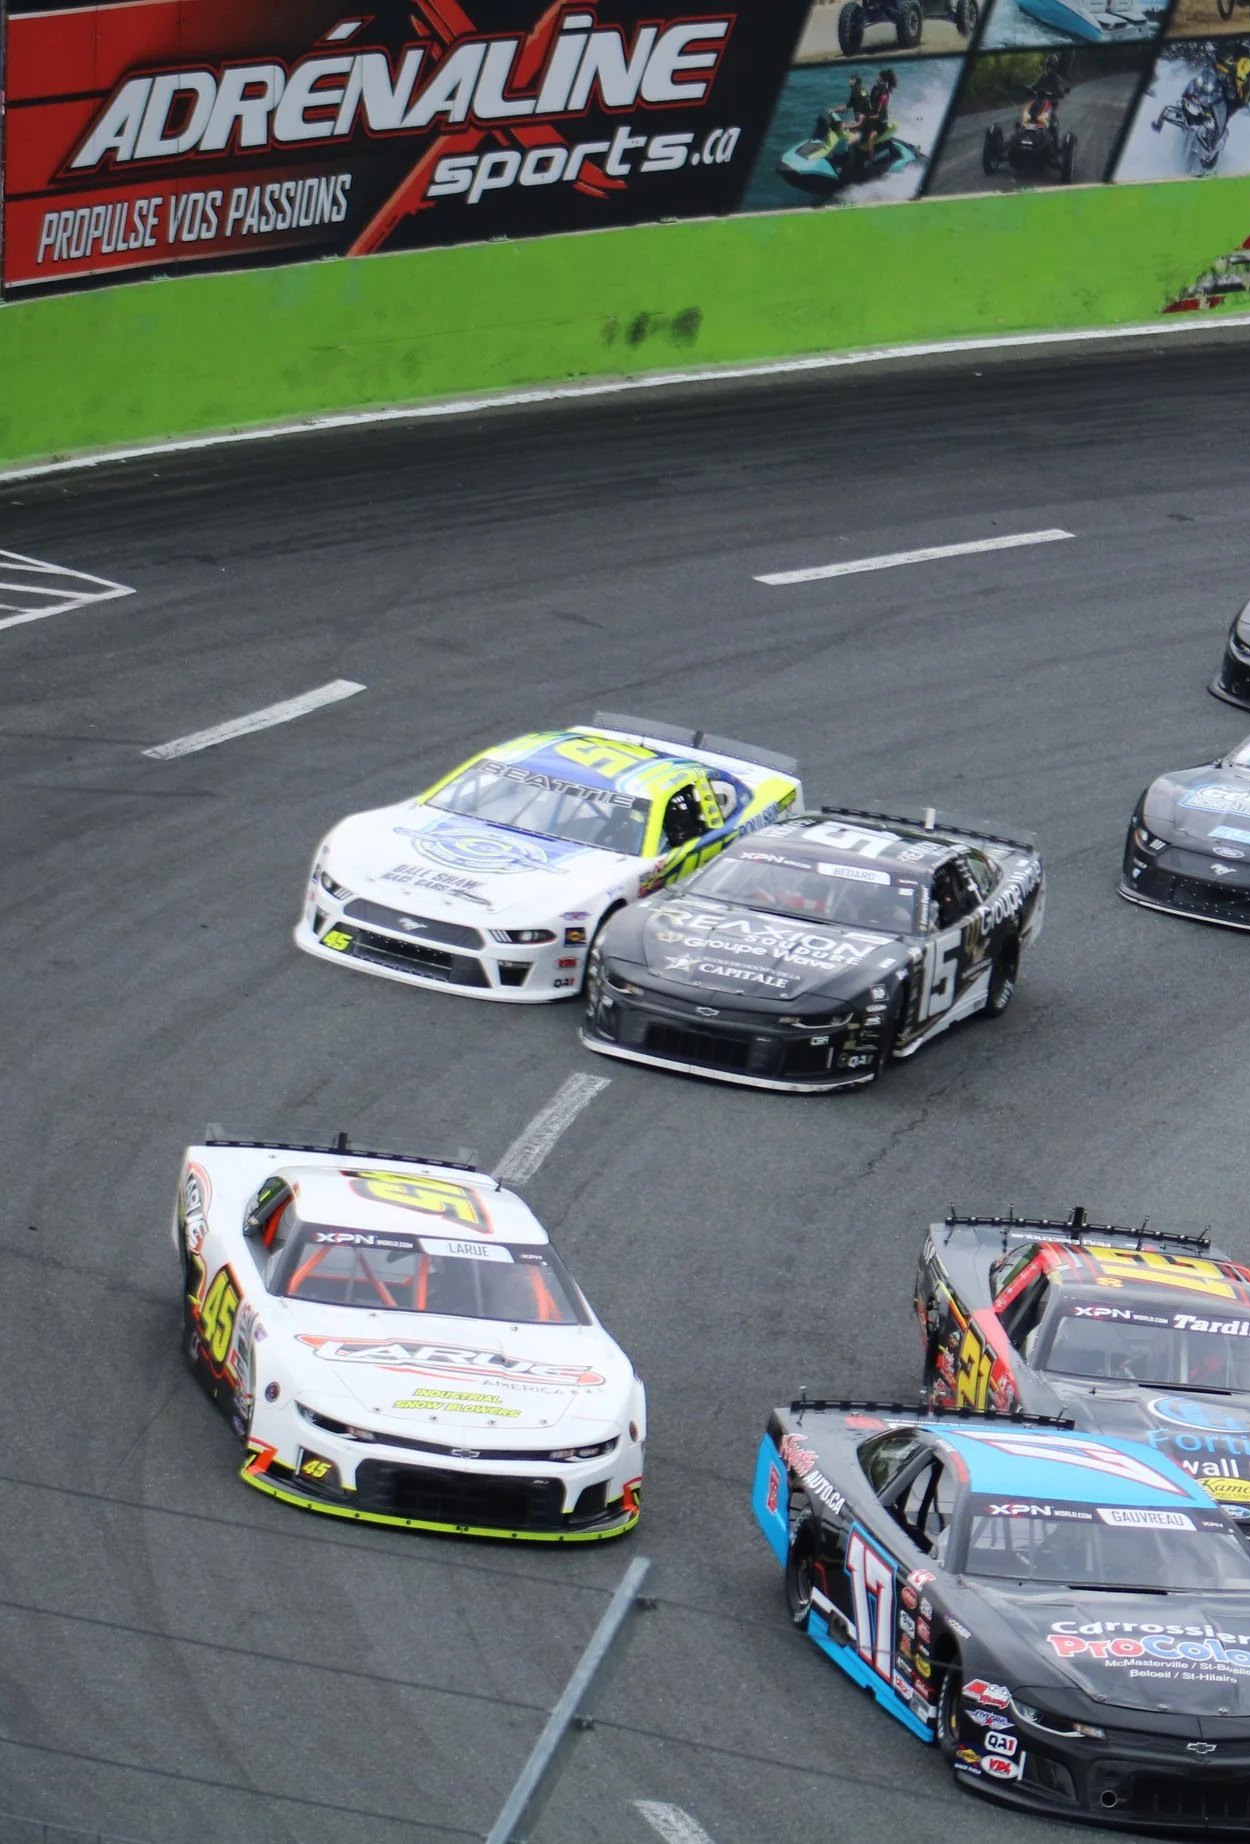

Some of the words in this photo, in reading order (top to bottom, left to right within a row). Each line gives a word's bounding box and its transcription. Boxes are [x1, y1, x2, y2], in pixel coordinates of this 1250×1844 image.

[428, 125, 741, 204] sports.ca
[36, 197, 161, 264] PROPULSE
[166, 191, 221, 244] VOS
[225, 174, 353, 236] PASSIONS
[479, 759, 637, 809] BEATTIE
[321, 928, 352, 951] 45
[649, 906, 876, 958] REAXION
[682, 936, 768, 955] Groupe
[772, 948, 837, 970] Wave
[743, 933, 864, 966] SOUDURE
[699, 962, 790, 989] CAPITALE
[917, 929, 963, 1023] 15
[314, 1231, 378, 1245] XPN
[448, 1241, 491, 1258] LARUE
[200, 1270, 241, 1364] 45
[1073, 1305, 1131, 1320] XPN
[1132, 1313, 1169, 1325] WORLD.COM
[313, 1339, 594, 1386] LARUE
[956, 1320, 998, 1412] 21
[413, 1388, 504, 1405] INDUSTRIAL
[481, 1378, 569, 1396] AMERICA
[393, 1400, 443, 1412] SNOW
[443, 1401, 522, 1419] BLOWERS
[302, 1459, 331, 1480] 45
[803, 1469, 846, 1516] AUTO.CA
[989, 1503, 1053, 1516] XPN
[1054, 1510, 1093, 1520] WORLD.COM
[1111, 1510, 1185, 1526] GAUVREAU
[847, 1523, 898, 1683] 17
[1105, 1658, 1189, 1669] McMasterville
[1130, 1669, 1172, 1680] Beloeil
[988, 1733, 1015, 1752] QA1
